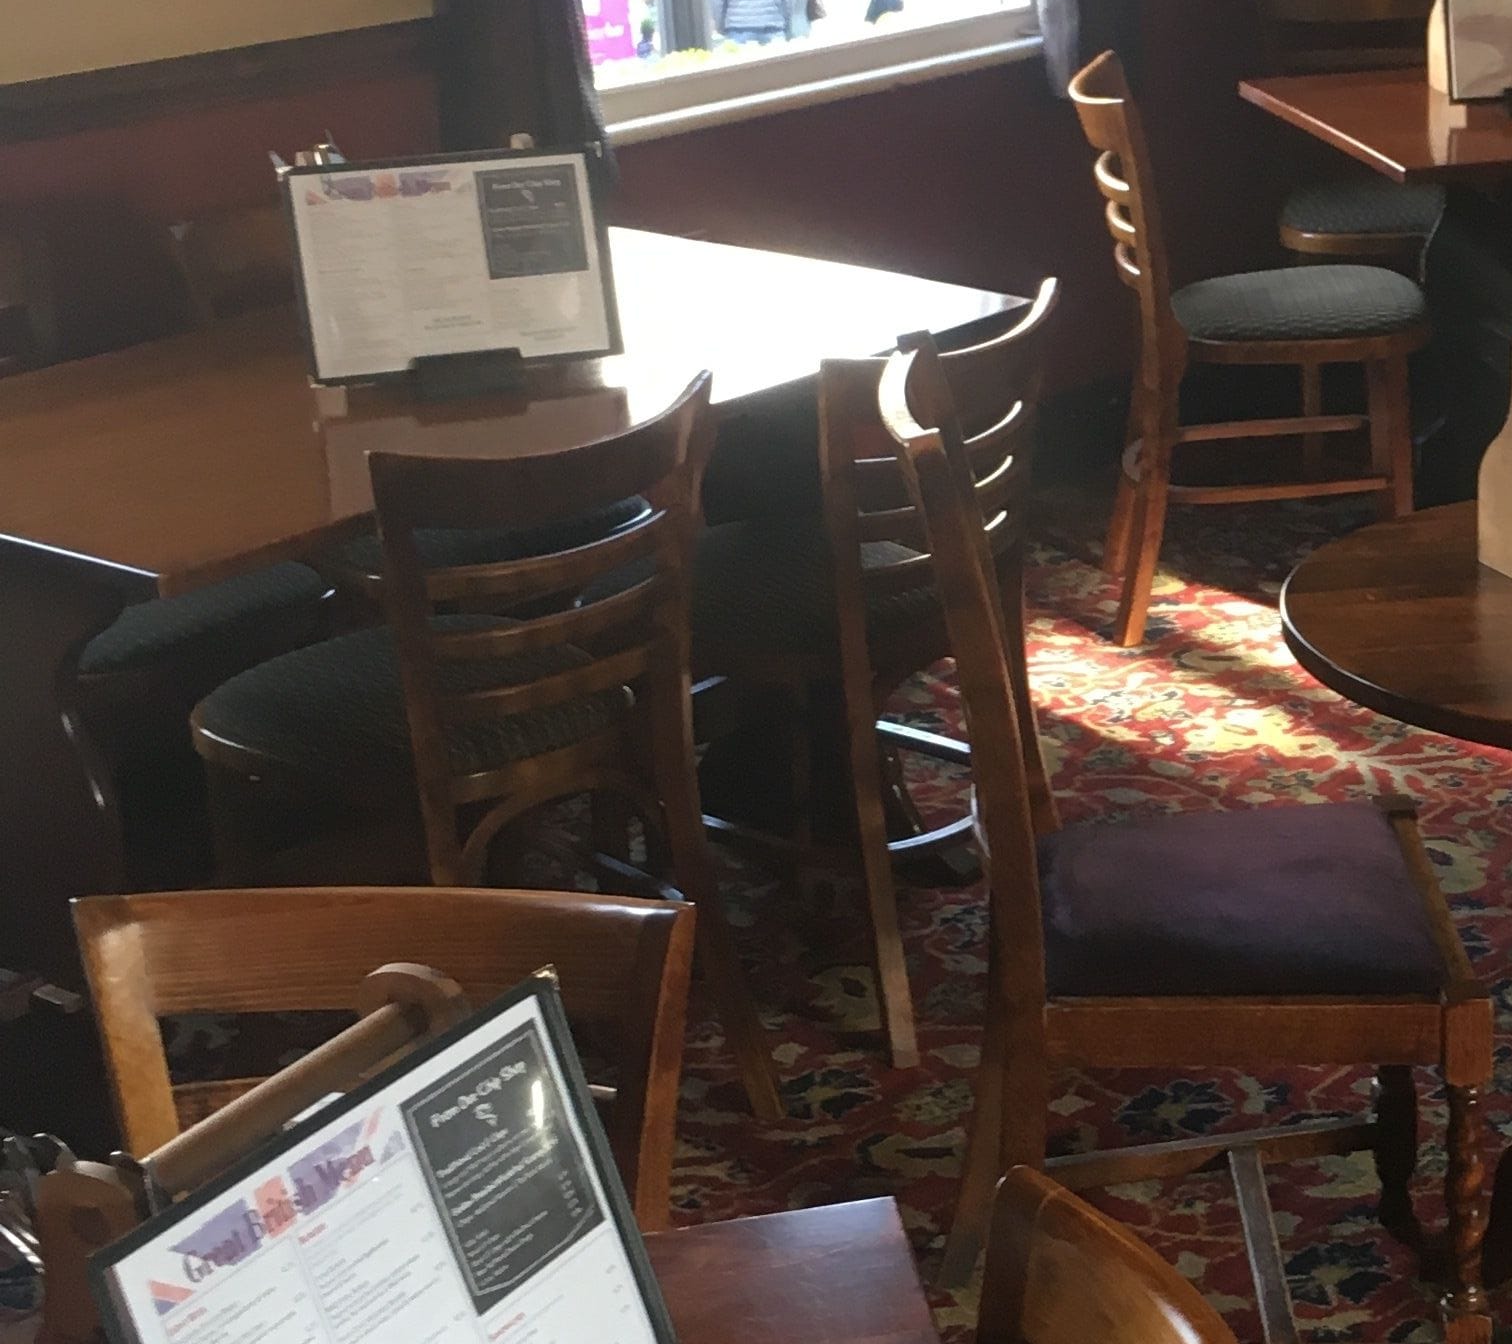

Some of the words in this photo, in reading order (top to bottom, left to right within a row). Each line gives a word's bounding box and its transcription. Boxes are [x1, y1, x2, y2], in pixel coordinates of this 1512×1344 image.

[182, 1229, 246, 1283] Great
[243, 1176, 318, 1241] British
[313, 1144, 376, 1189] Menu
